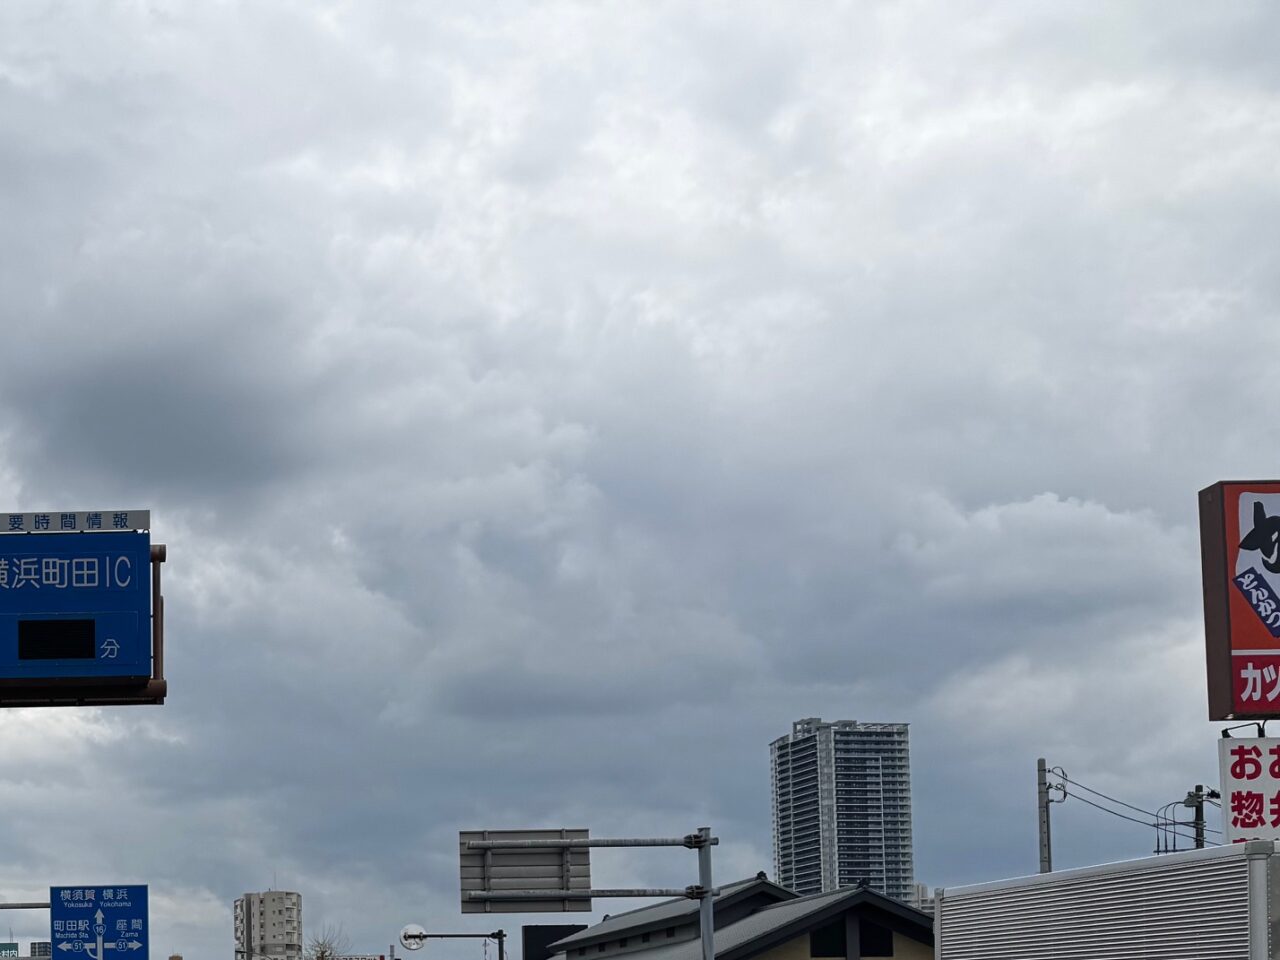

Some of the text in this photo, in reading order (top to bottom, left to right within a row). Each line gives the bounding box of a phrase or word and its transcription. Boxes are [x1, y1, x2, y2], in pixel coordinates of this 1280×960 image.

[100, 638, 120, 659] 分
[60, 888, 129, 901] 横須賀 横浜
[53, 920, 90, 931] 町田駅
[95, 926, 104, 934] 16
[116, 919, 143, 930] 座間
[74, 942, 83, 950] 51
[118, 941, 127, 949] 51
